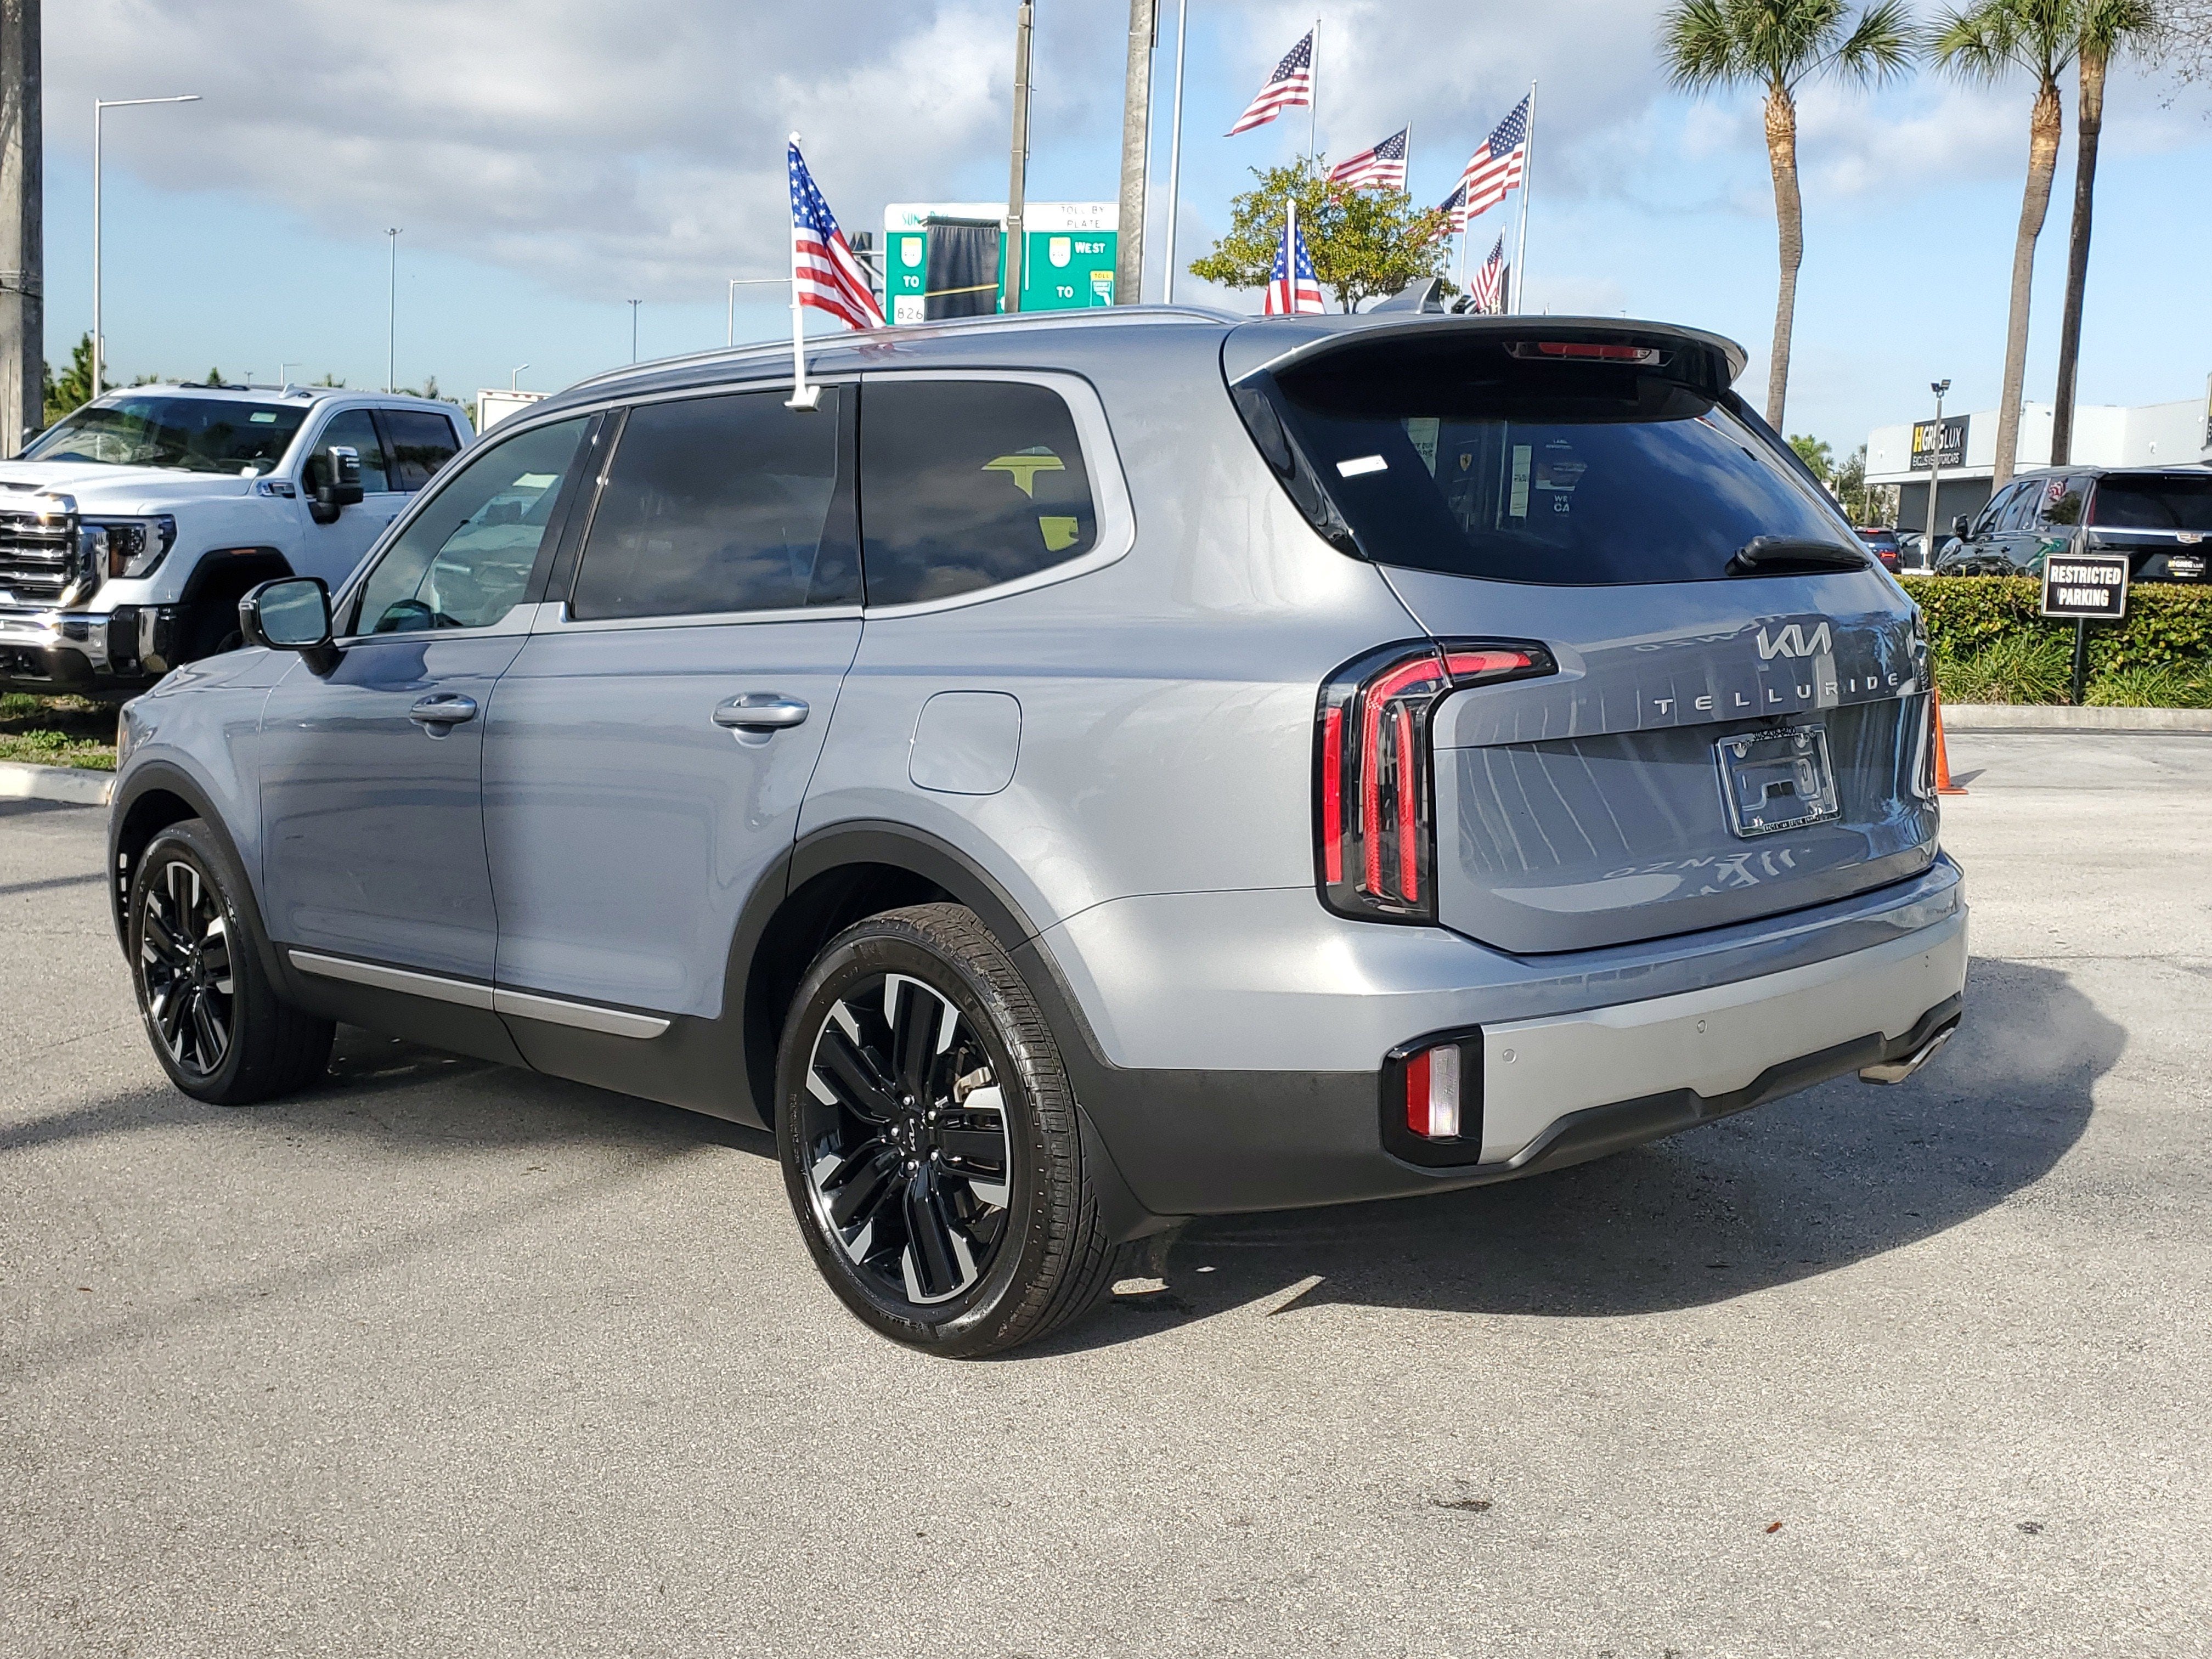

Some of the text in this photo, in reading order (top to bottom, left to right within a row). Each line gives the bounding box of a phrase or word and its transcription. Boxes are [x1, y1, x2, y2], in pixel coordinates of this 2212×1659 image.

[1092, 206, 1105, 214] BY
[1066, 219, 1101, 228] PLATE
[1074, 241, 1106, 254] WEST
[902, 275, 920, 288] TO
[1056, 285, 1074, 298] TO
[897, 307, 923, 319] 826
[2050, 565, 2121, 585] RESTRICTED
[2058, 588, 2109, 606] PARKING
[1654, 672, 1899, 715] TELLURIDE
